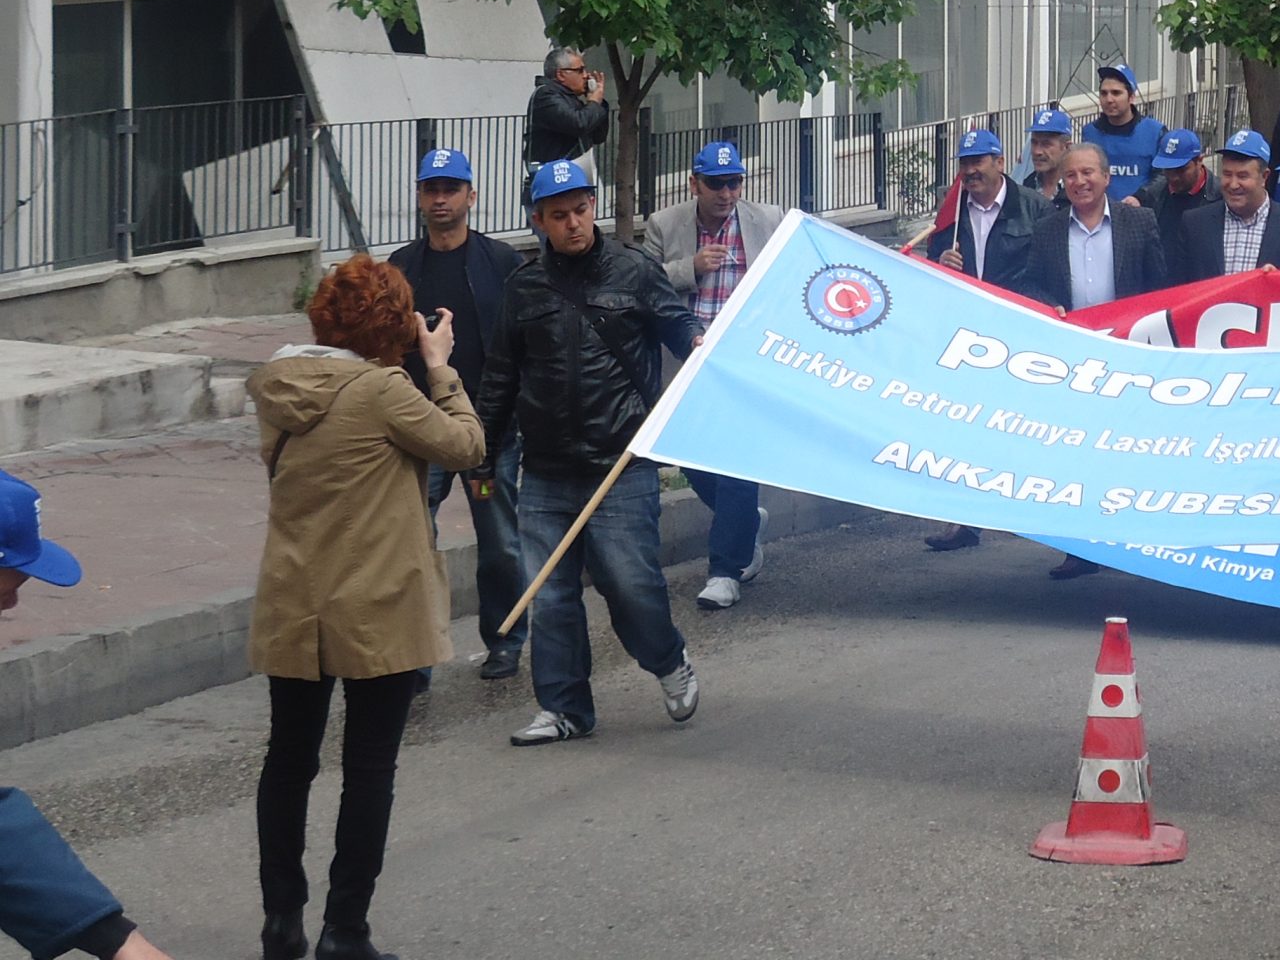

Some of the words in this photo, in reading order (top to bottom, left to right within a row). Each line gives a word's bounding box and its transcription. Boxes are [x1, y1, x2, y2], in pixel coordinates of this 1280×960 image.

[757, 329, 875, 392] Türkiye
[879, 379, 984, 424] Petrol
[986, 408, 1086, 446] Kimya
[1094, 427, 1197, 458] Lastik
[872, 441, 1084, 508] ANKARA
[1200, 554, 1275, 582] Kimya
